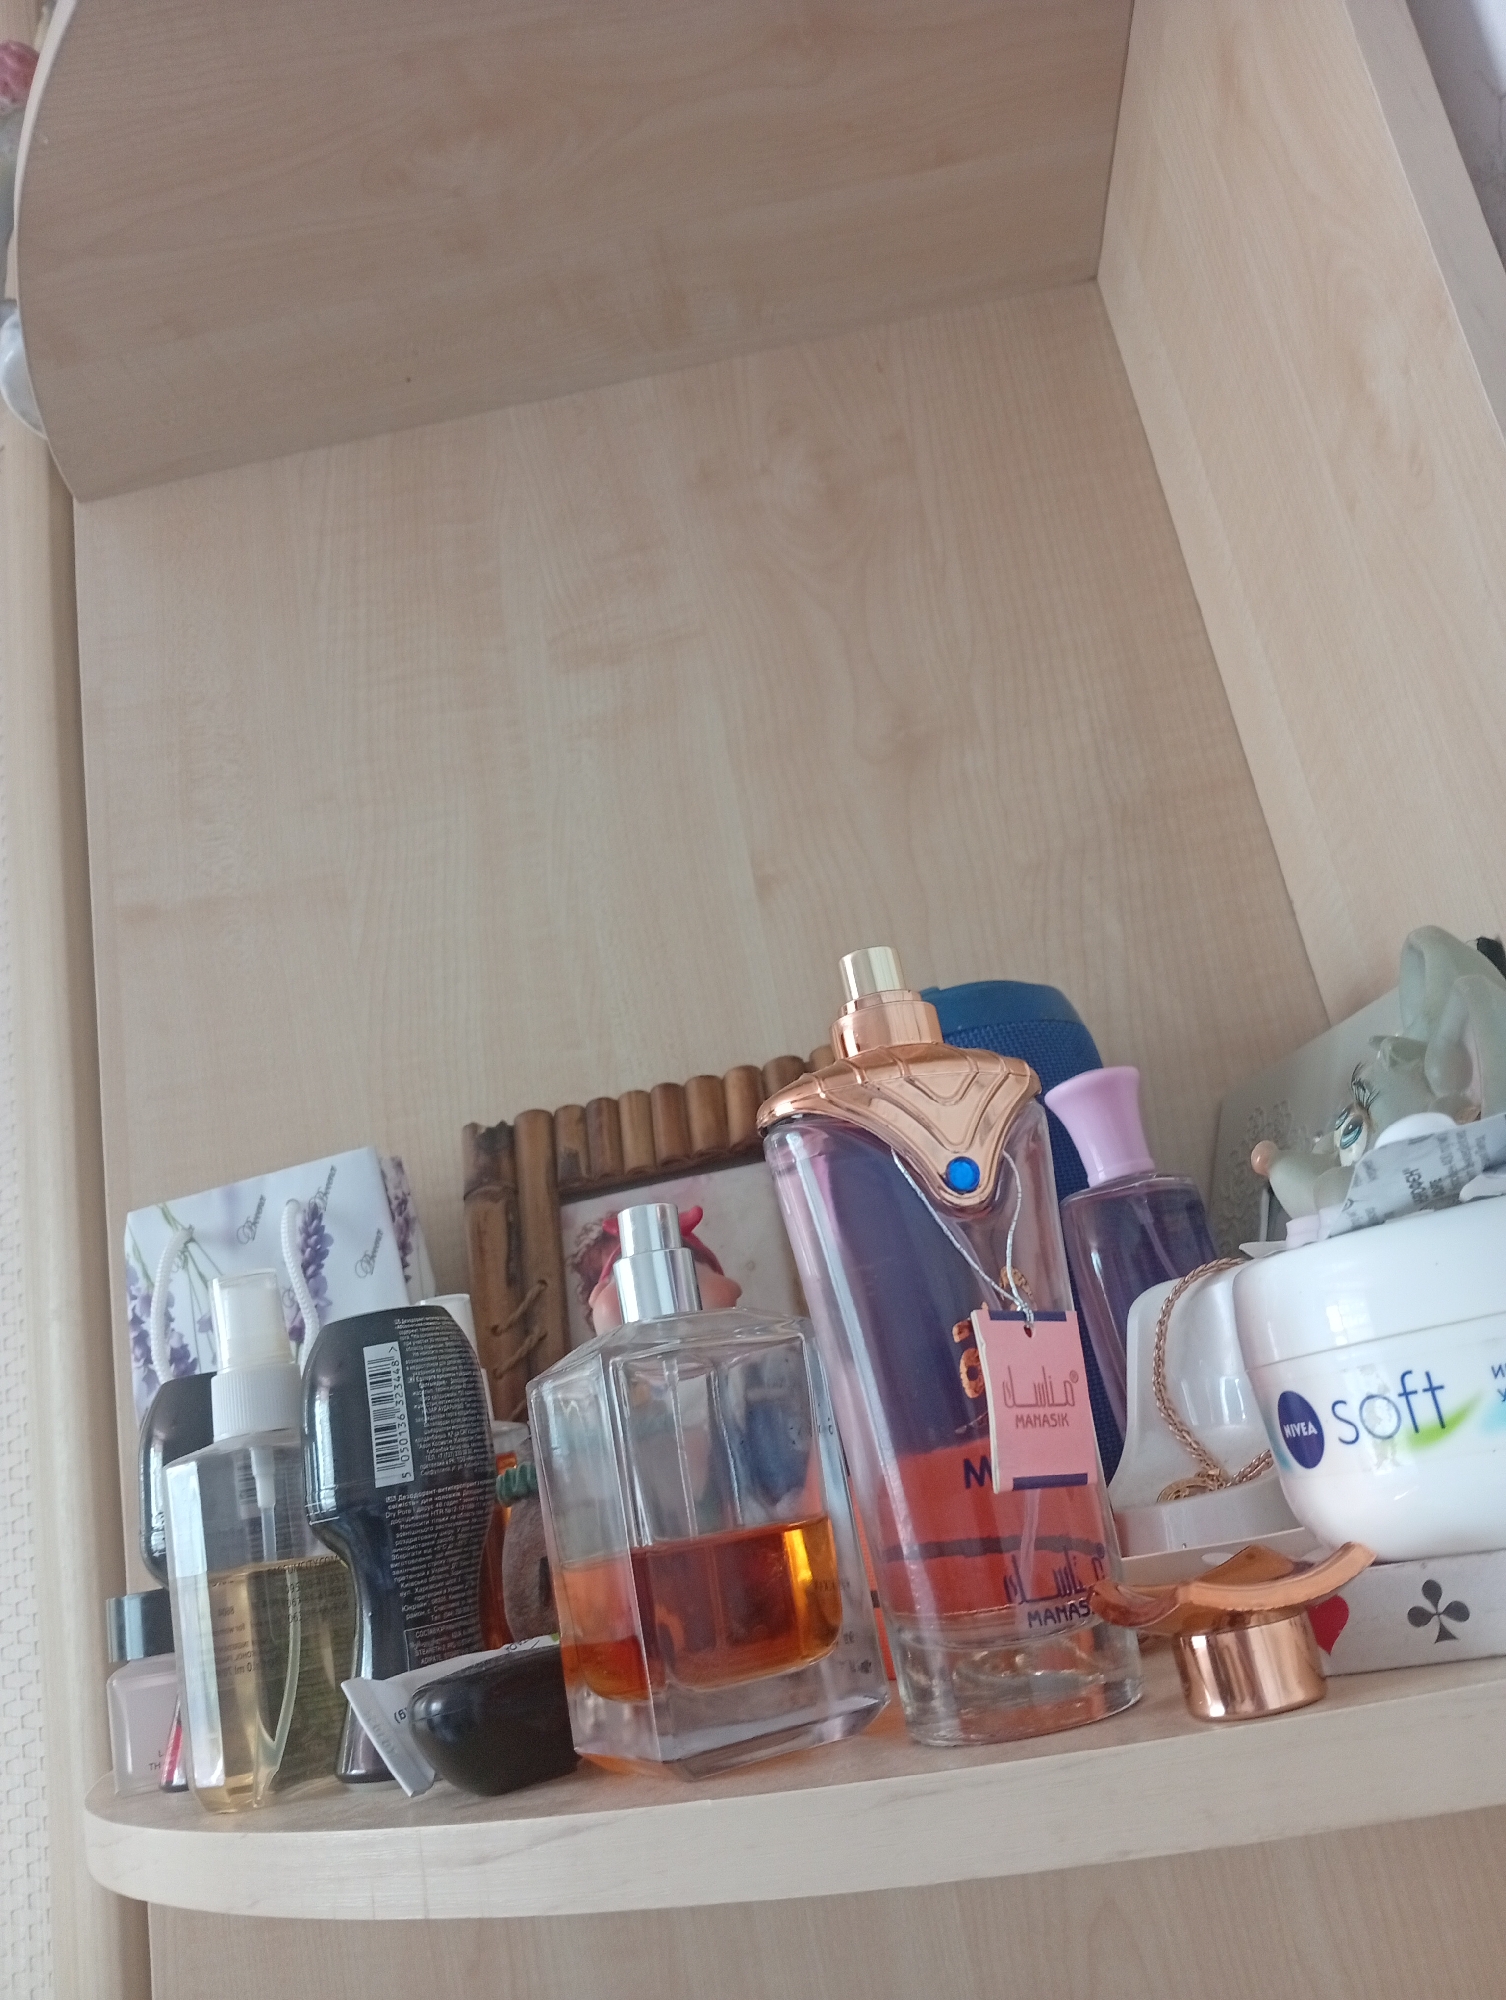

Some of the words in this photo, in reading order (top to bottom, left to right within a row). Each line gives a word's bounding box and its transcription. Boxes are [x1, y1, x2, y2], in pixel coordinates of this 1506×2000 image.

[1015, 1412, 1070, 1429] MANASIK
[1283, 1421, 1318, 1439] NIVEA
[1027, 1599, 1096, 1628] MANAS
